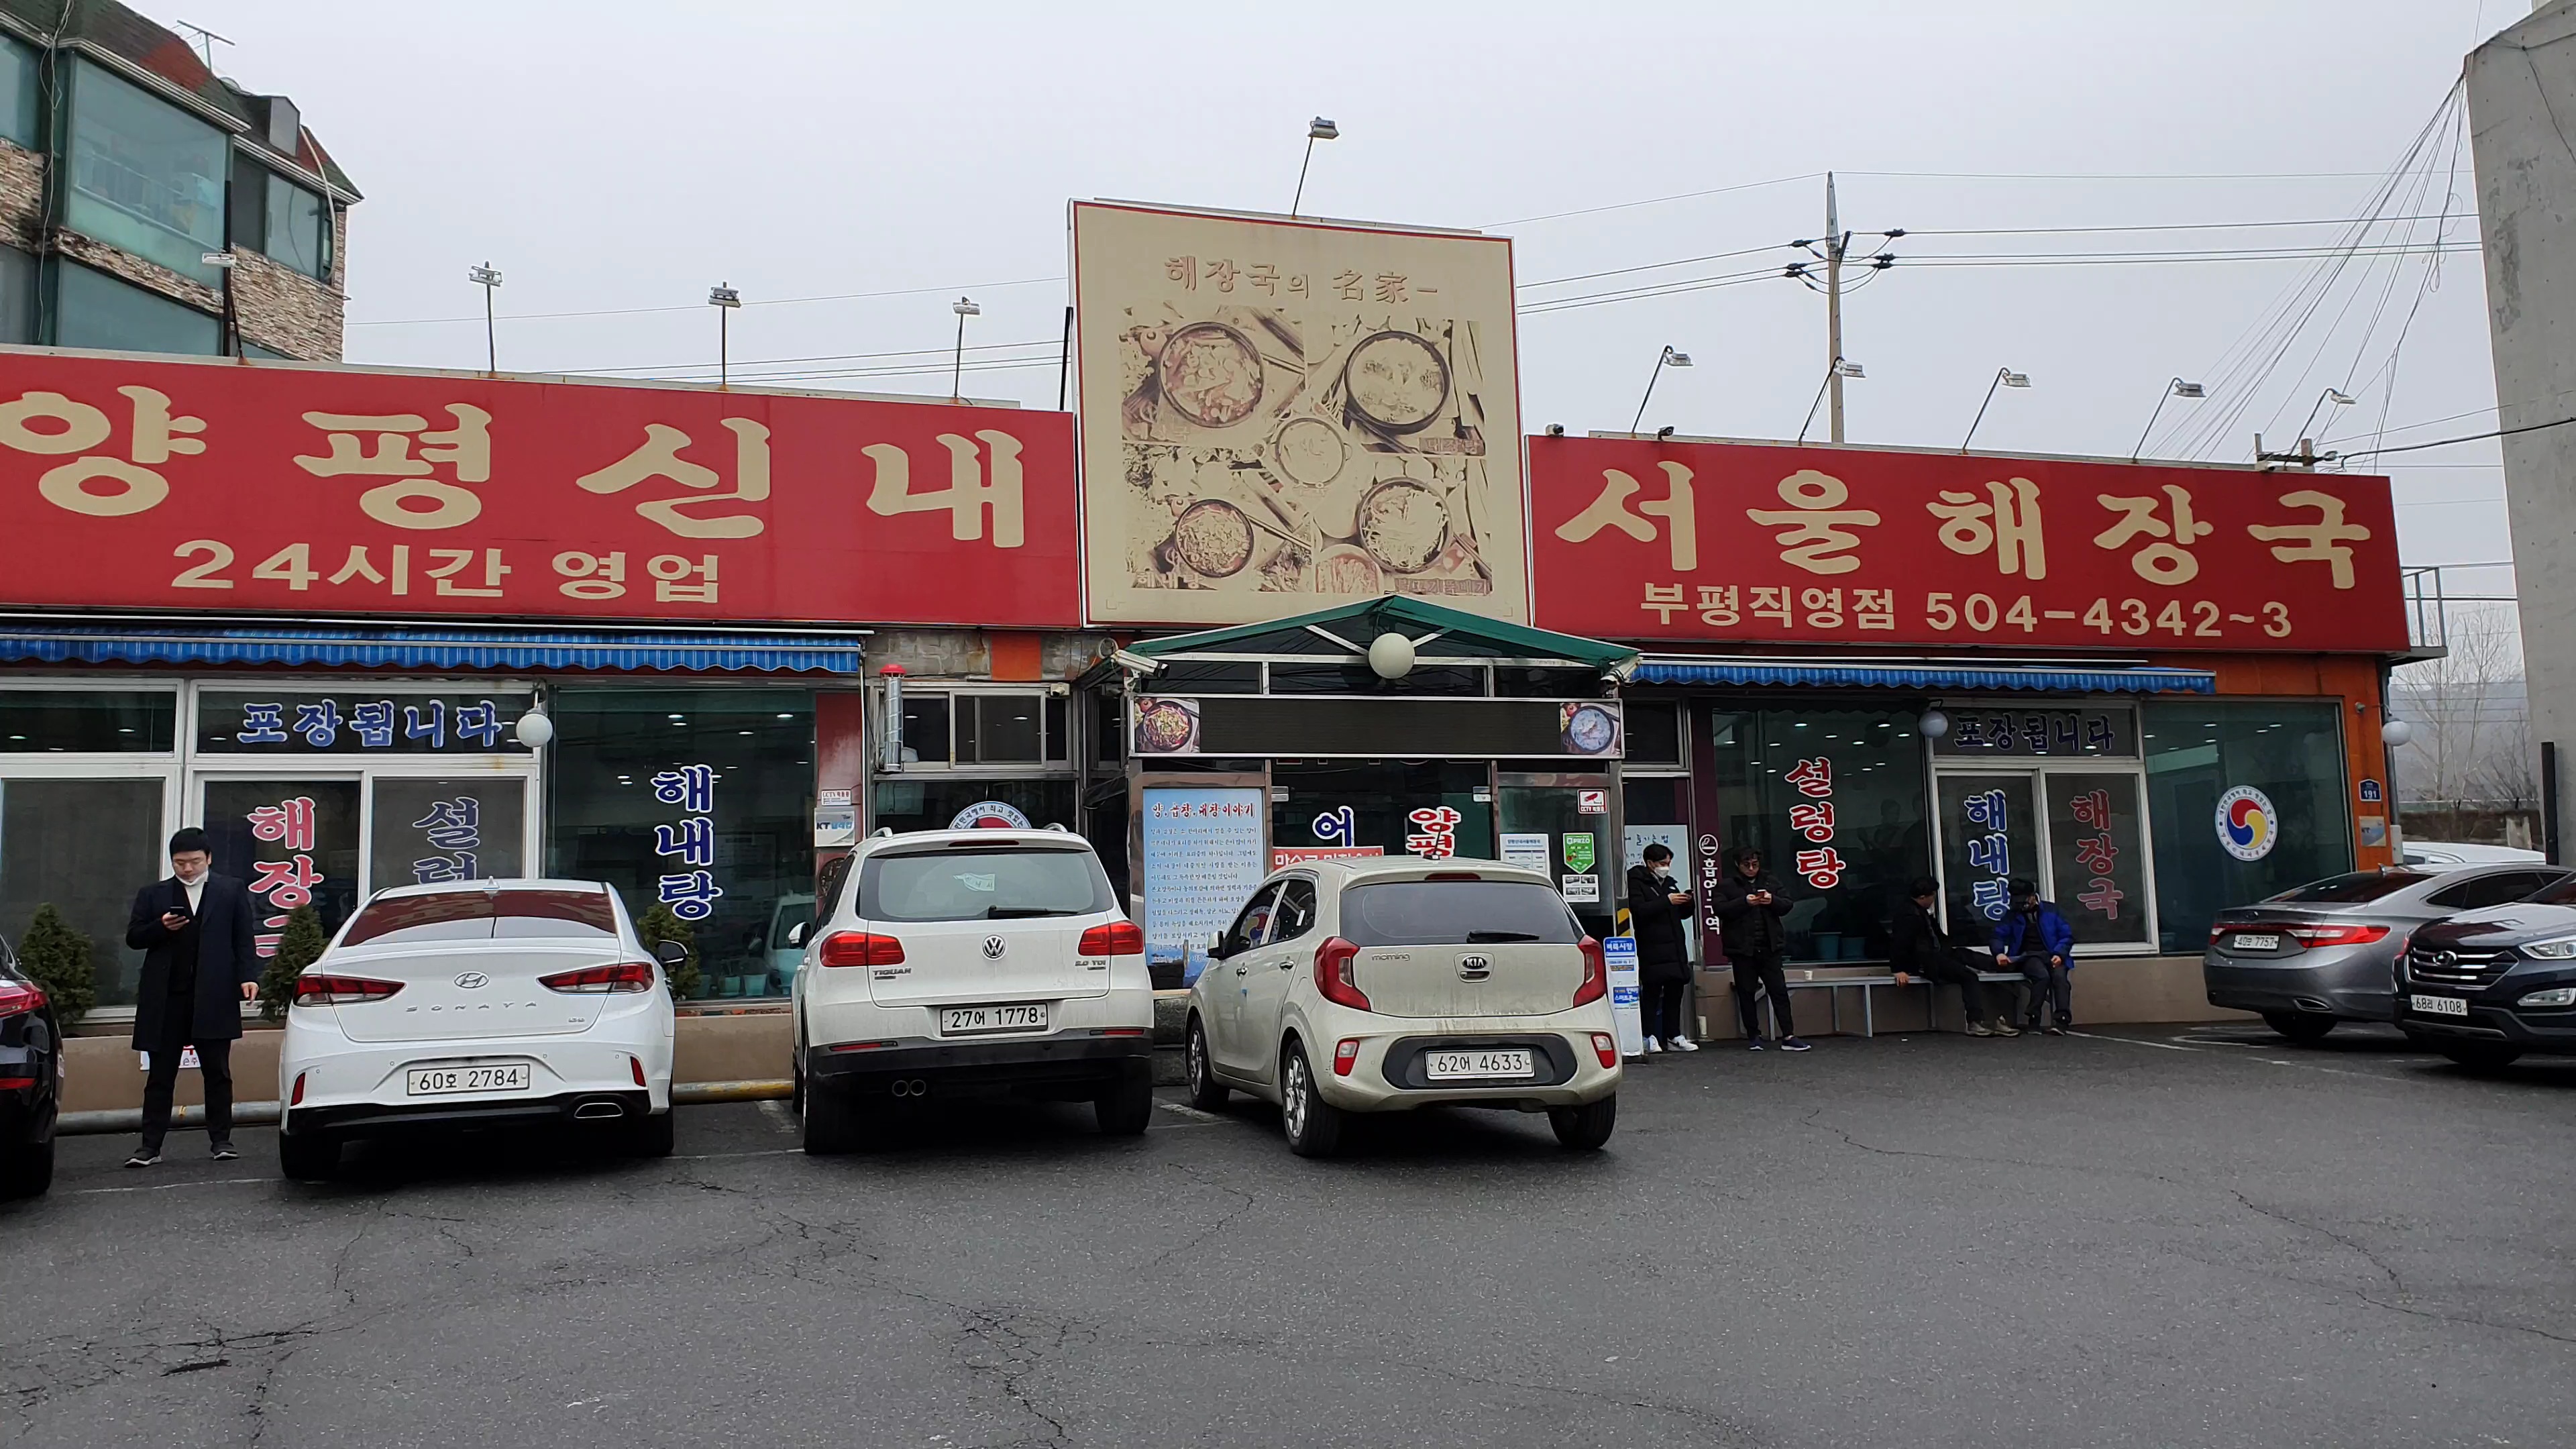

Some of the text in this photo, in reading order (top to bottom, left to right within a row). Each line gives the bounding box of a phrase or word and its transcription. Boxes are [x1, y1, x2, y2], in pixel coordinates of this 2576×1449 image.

[1164, 255, 1309, 299] 해장국의
[0, 384, 1024, 549] 양평신내
[1554, 461, 2371, 589] 서울해장국
[171, 539, 719, 603] 24시간 영업
[1640, 582, 2292, 638] 부평직영점 504-4342~3
[236, 698, 503, 748] 포장됩니다
[1953, 712, 2115, 751] 포장됩니다
[2363, 790, 2377, 798] 191
[650, 763, 724, 920] 해내탕
[1784, 756, 1846, 890] 설렁탕
[1964, 788, 2011, 922] 해내탕
[2070, 788, 2124, 920] 해장국
[1371, 953, 1410, 961] morning
[1466, 958, 1484, 967] KIA
[951, 1006, 1038, 1028] 27어 1778
[2437, 999, 2462, 1013] 6108
[419, 1068, 519, 1091] 60호 2784
[1438, 1054, 1522, 1072] 62어 4633
